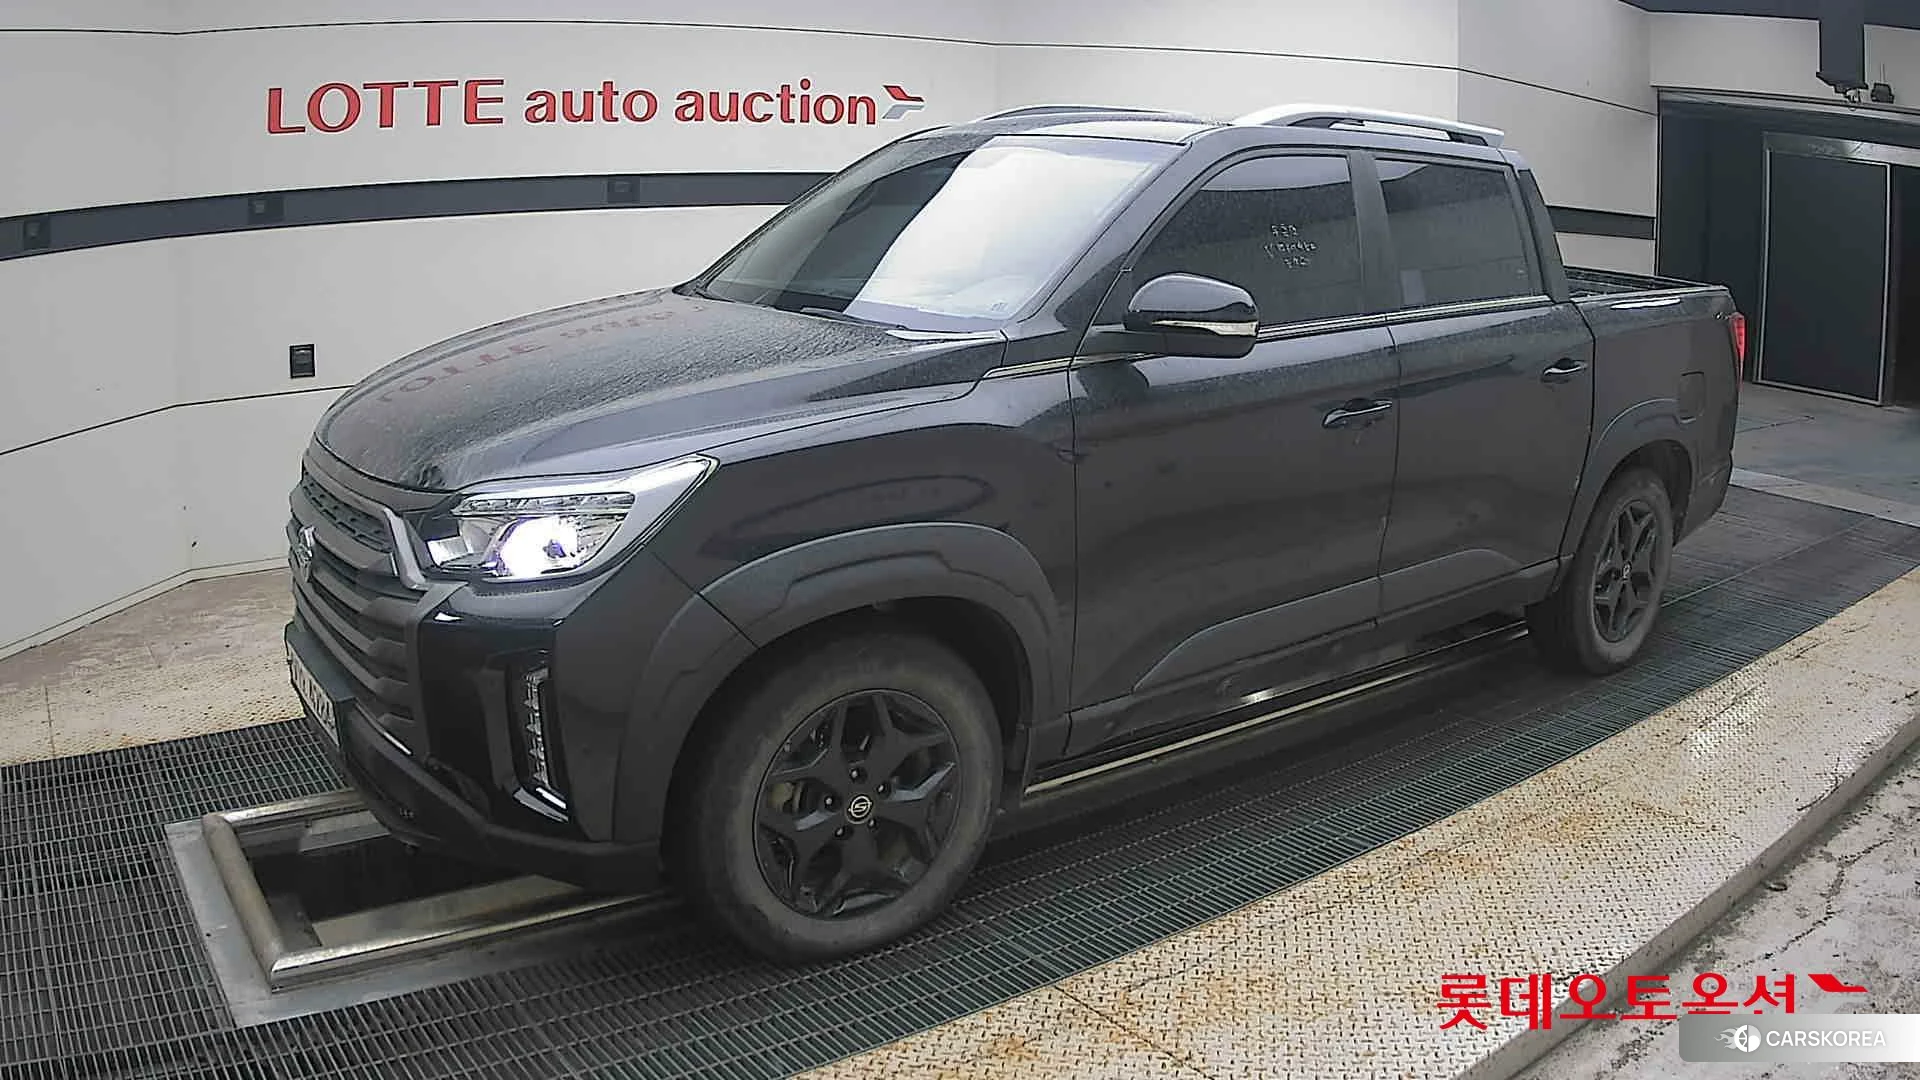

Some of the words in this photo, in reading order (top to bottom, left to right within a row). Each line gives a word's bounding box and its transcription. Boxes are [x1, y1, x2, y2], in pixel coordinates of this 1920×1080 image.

[266, 79, 504, 134] LOTTE
[524, 81, 657, 124] auto
[674, 79, 877, 126] auction
